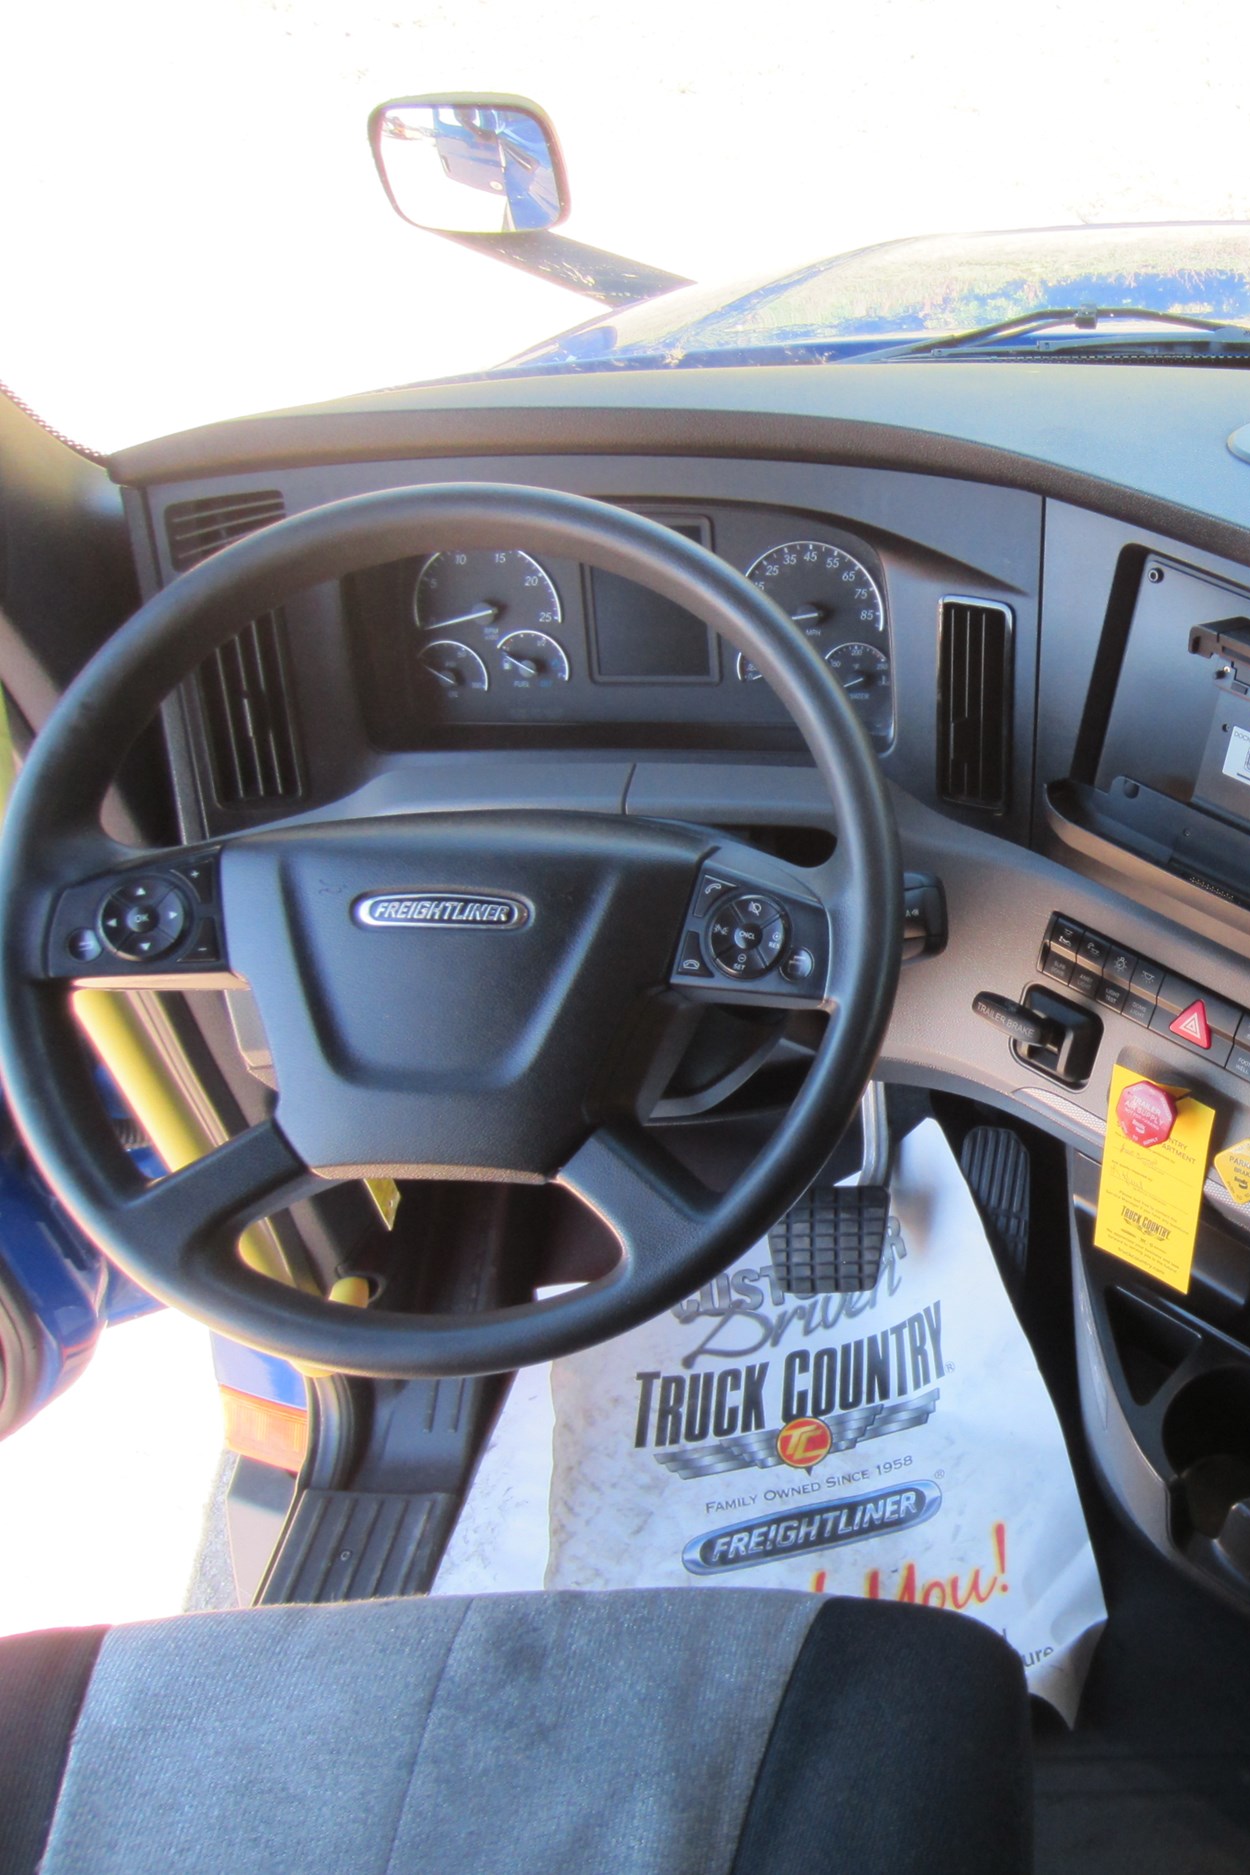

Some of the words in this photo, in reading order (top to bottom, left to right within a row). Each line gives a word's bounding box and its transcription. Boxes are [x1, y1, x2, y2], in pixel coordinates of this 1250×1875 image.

[455, 554, 467, 565] 10
[495, 553, 506, 564] 15
[784, 554, 797, 566] 35
[803, 552, 818, 562] 45
[826, 558, 840, 568] 55
[766, 565, 780, 576] 25
[524, 576, 538, 587] 20
[842, 571, 856, 582] 65
[854, 588, 868, 600] 75
[539, 612, 552, 623] 25
[860, 610, 874, 620] 85
[806, 629, 822, 637] MPH
[1234, 730, 1250, 743] DOCK
[374, 900, 510, 922] FREIGHTLINER
[136, 914, 150, 923] OK
[738, 930, 756, 941] CNCL
[733, 963, 747, 972] SET
[1106, 988, 1121, 998] LIGHT
[1105, 994, 1117, 1004] TEST
[978, 1002, 1006, 1027] TRAILER
[1006, 1020, 1036, 1039] BRAKE
[1235, 1064, 1249, 1075] WELL
[1134, 1097, 1161, 1114] TRAILER
[1124, 1100, 1138, 1110] AIR
[1140, 1106, 1162, 1123] SUPPLY
[1168, 1137, 1188, 1151] NTRY
[1162, 1144, 1197, 1165] ARTMENT
[1120, 1205, 1142, 1225] TRUCK
[1142, 1216, 1173, 1241] COUNTRY
[682, 1254, 903, 1370] Driven
[634, 1361, 770, 1449] TRUCK
[781, 1300, 945, 1424] COUNTRY
[706, 1494, 758, 1514] FAMILY
[764, 1482, 820, 1502] OWNED
[826, 1469, 870, 1488] SINCE
[876, 1454, 913, 1476] 1958
[712, 1490, 918, 1562] FREIGHTLINER
